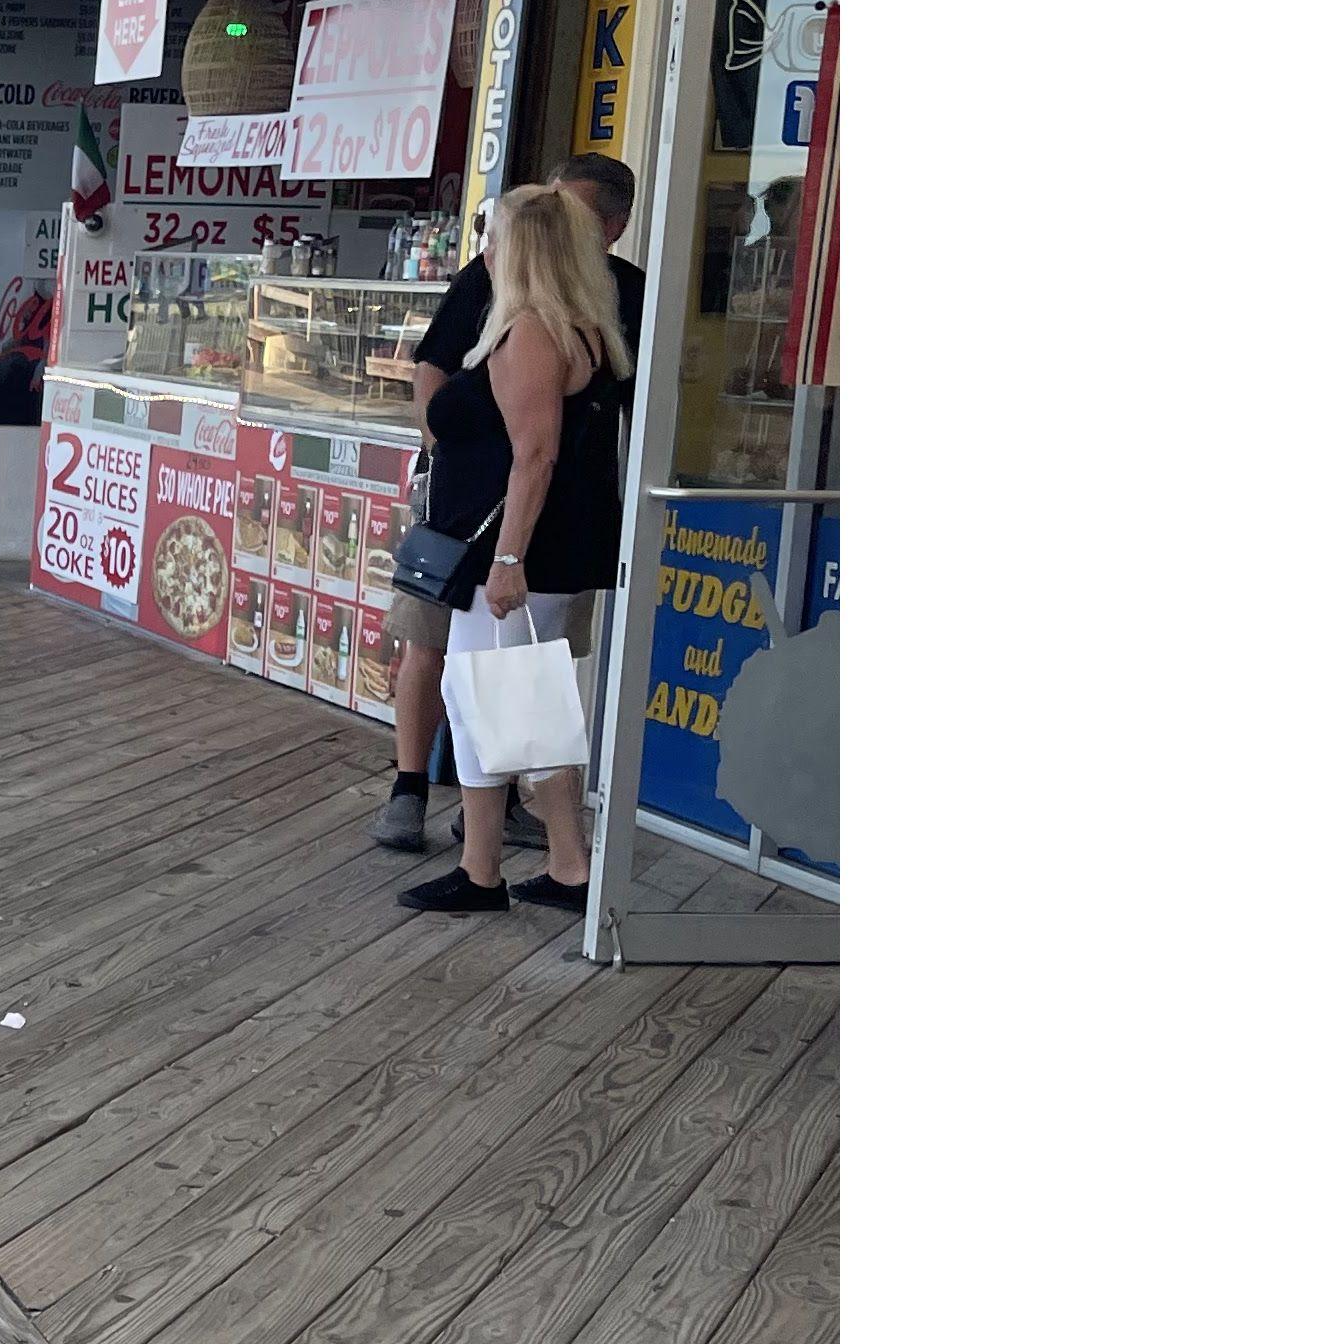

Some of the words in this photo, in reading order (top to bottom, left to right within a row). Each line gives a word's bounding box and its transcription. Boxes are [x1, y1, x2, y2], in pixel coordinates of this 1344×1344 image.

[113, 14, 148, 48] HERE
[26, 119, 71, 133] BEVERAGES
[290, 111, 329, 174] 12
[328, 123, 366, 174] for
[368, 105, 432, 173] $10
[36, 218, 60, 239] AI
[143, 212, 181, 243] 32
[191, 219, 228, 245] oz
[251, 212, 301, 249] $5
[51, 431, 84, 498] 2
[86, 442, 143, 482] CHEESE
[83, 474, 139, 515] SLICES
[156, 463, 177, 506] $30
[177, 469, 214, 516] WHOLE
[46, 505, 80, 545] 20
[101, 534, 132, 581] $10
[663, 508, 768, 570] Homemade
[44, 543, 96, 581] COKE
[683, 637, 724, 677] and
